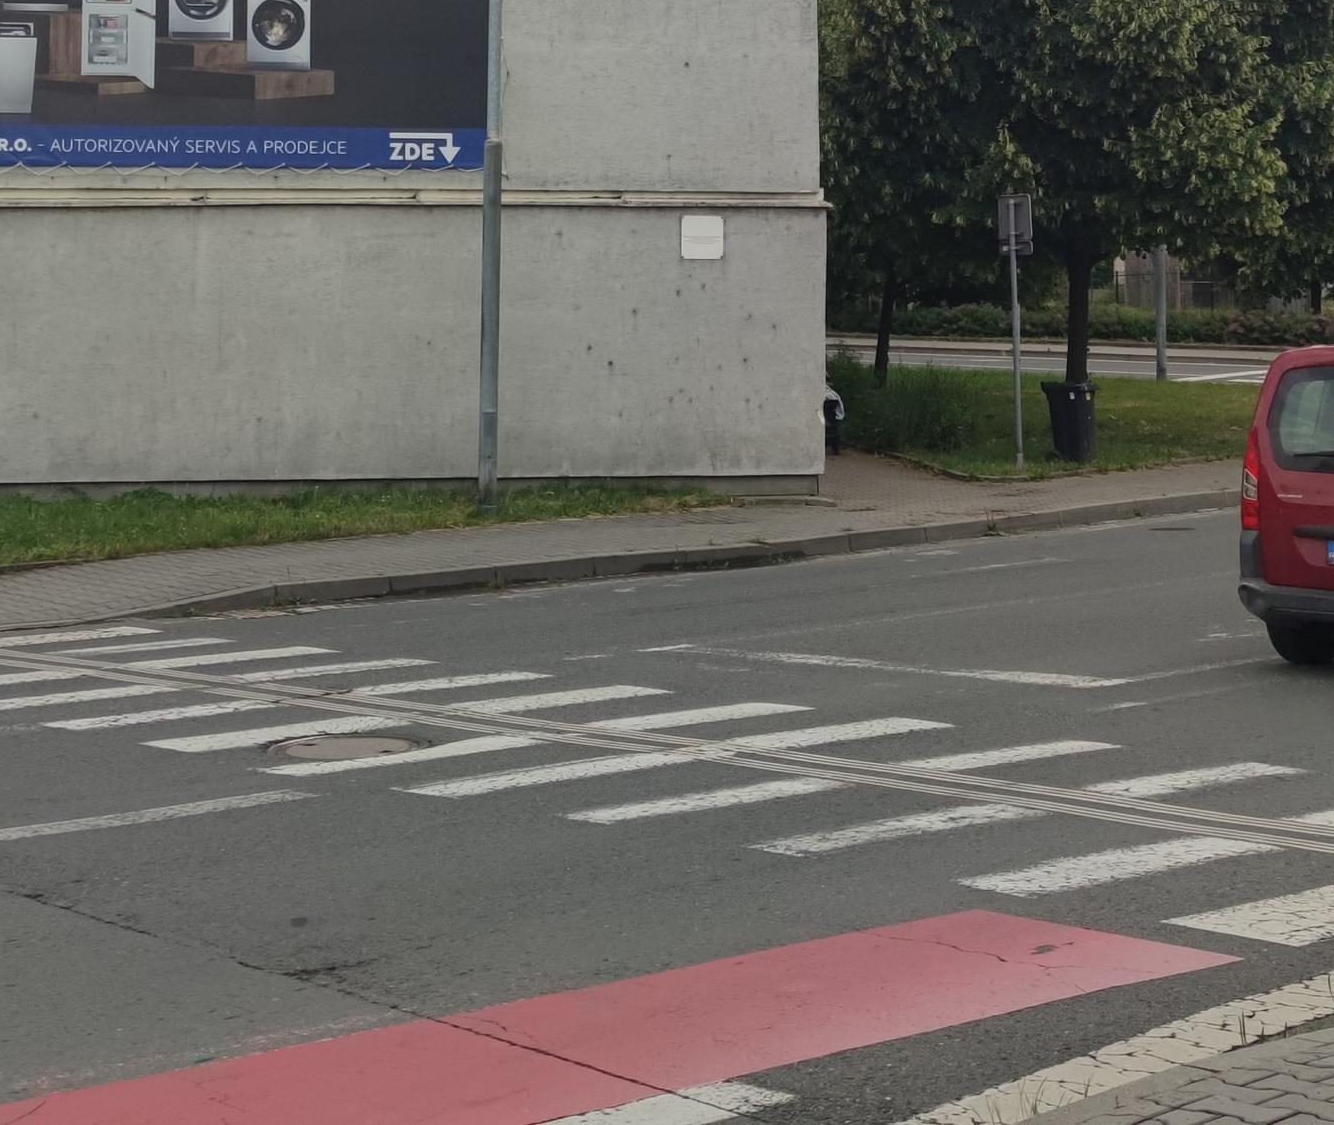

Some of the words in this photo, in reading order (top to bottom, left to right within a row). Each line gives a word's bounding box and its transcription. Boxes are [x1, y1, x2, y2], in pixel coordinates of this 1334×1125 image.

[50, 136, 180, 153] AUTORIZOVANÝ
[185, 139, 241, 154] SERVIS
[246, 140, 258, 154] A
[264, 140, 347, 155] PRODEJCE
[389, 142, 435, 161] ZDE
